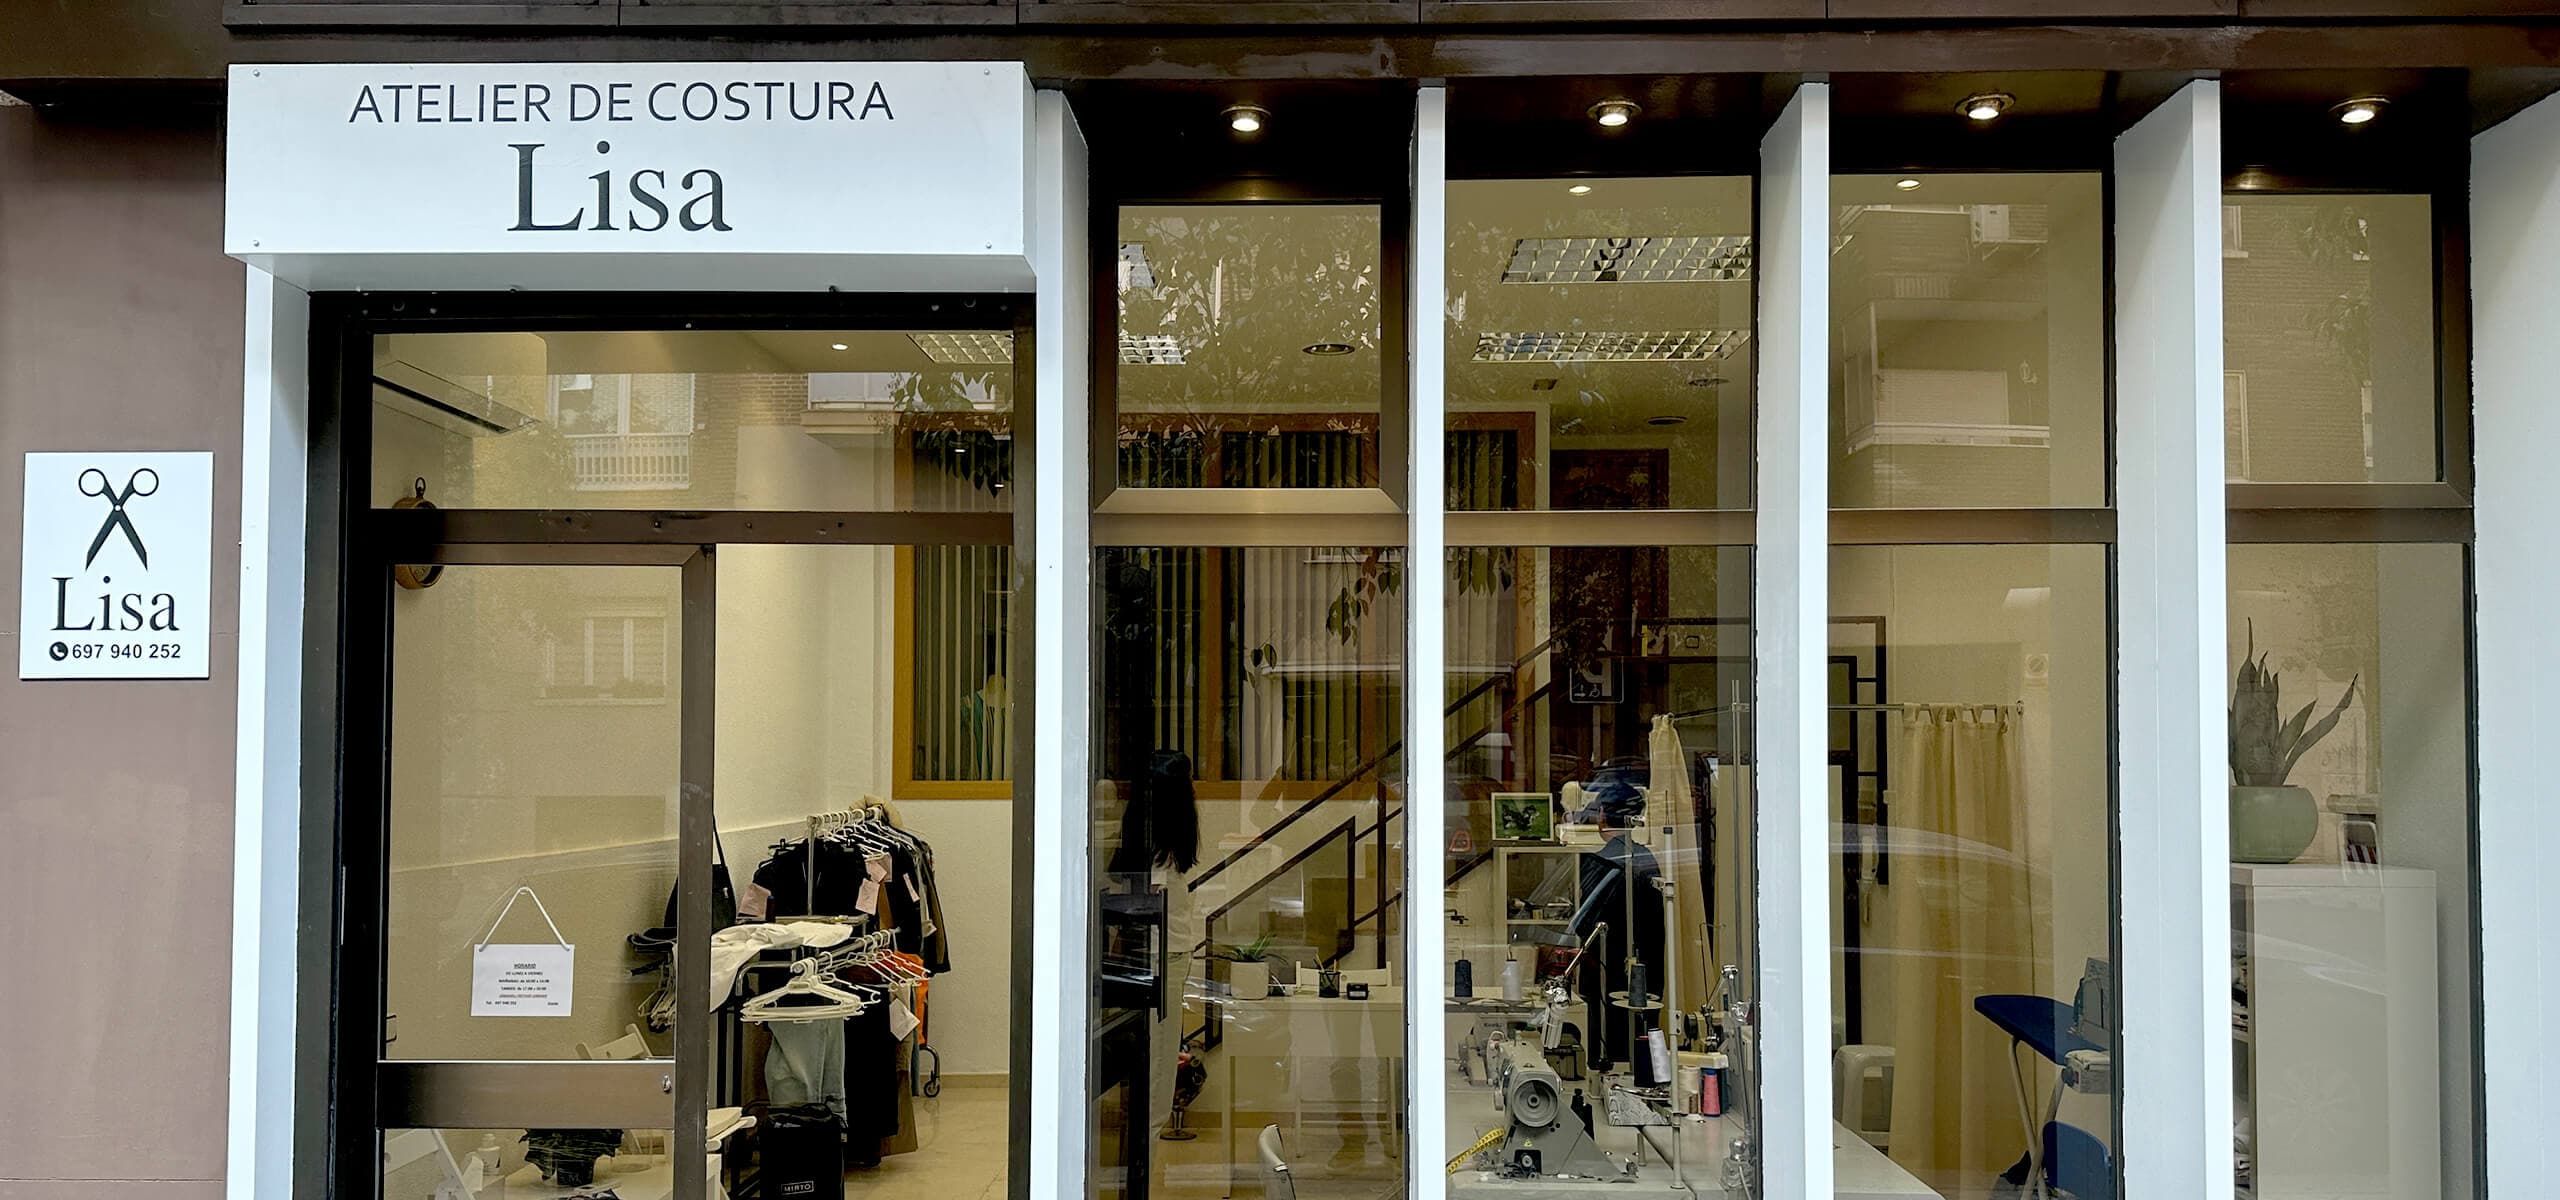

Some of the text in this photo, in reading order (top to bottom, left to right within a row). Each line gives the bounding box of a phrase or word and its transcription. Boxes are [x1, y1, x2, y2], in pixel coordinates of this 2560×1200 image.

[348, 81, 895, 123] ATELIER DE COSTURA
[506, 140, 733, 233] Lisa
[50, 574, 180, 632] Lisa
[72, 643, 181, 660] 697 940 252
[783, 1183, 811, 1193] MIRTO
